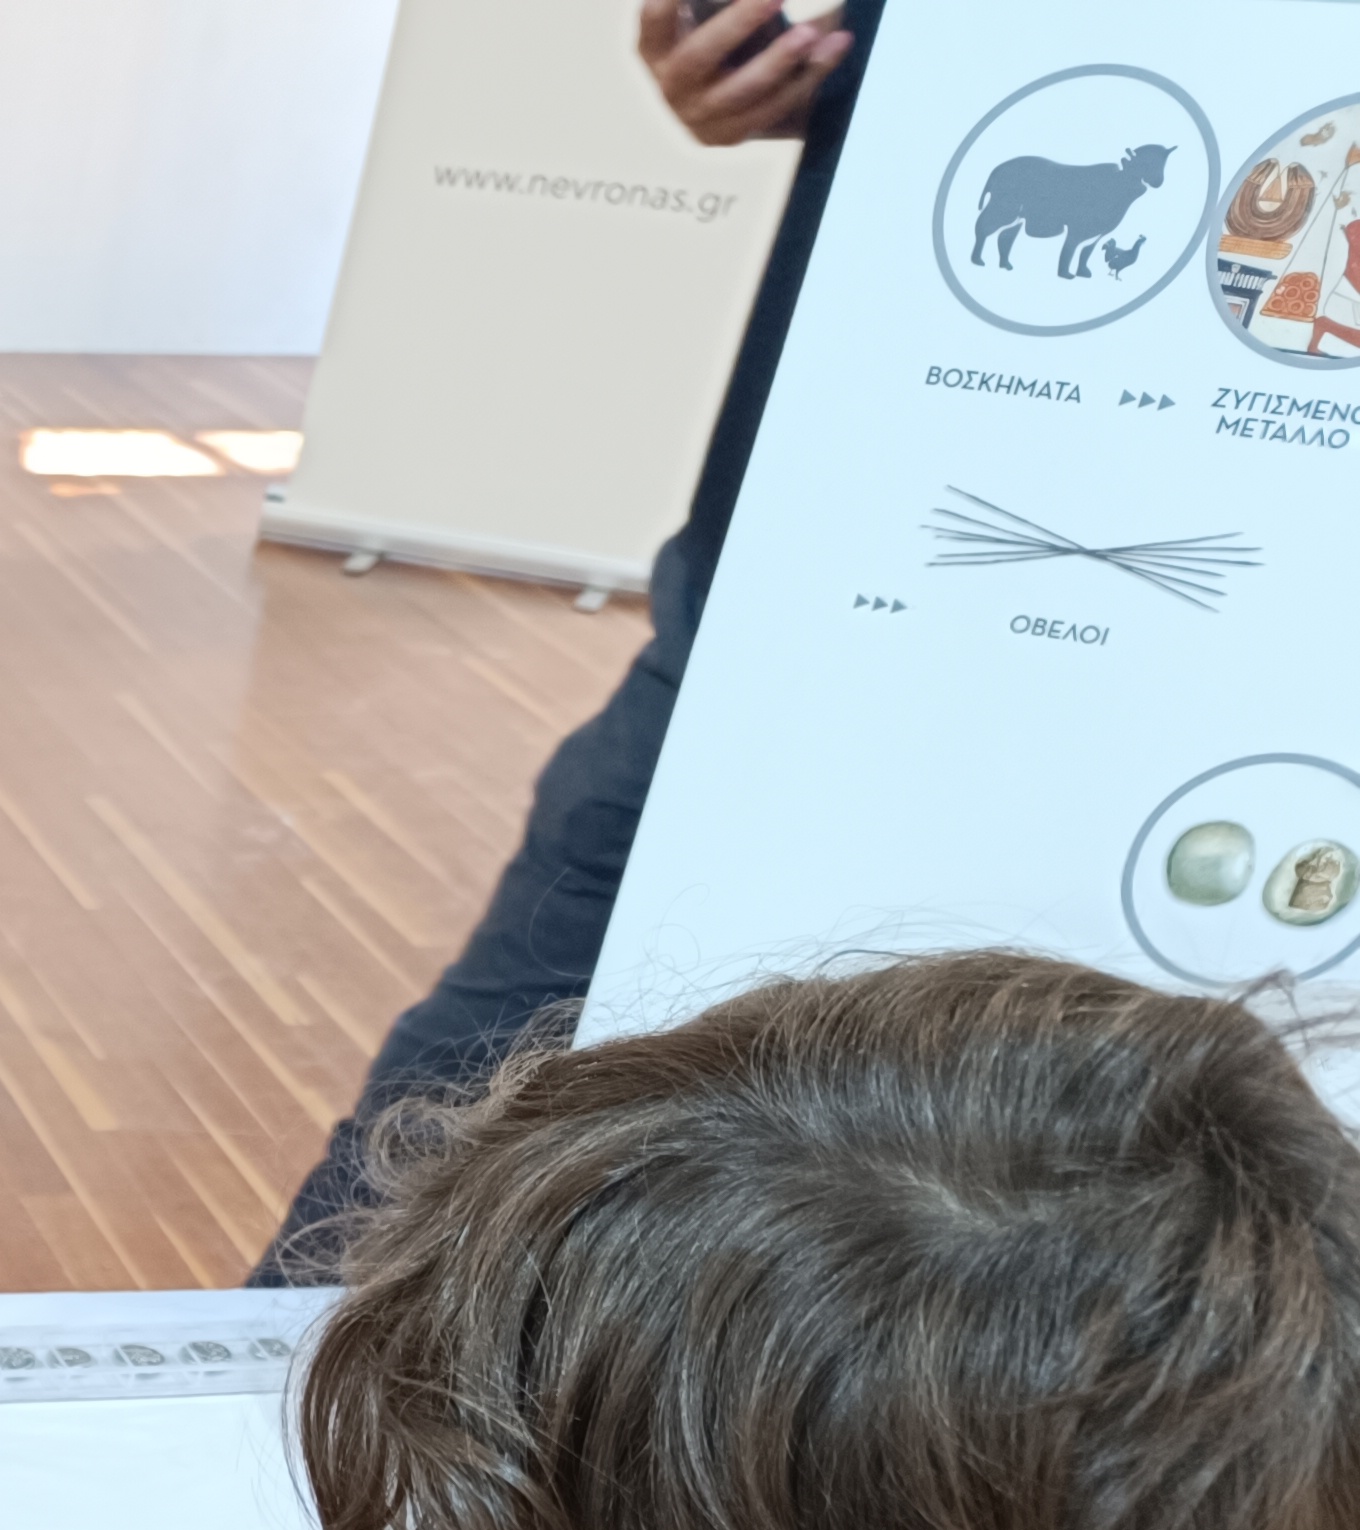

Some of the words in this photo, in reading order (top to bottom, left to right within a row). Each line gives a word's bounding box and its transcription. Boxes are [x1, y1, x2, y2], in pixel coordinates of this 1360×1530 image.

[434, 164, 739, 223] www.nevronas.gr
[925, 365, 1082, 404] ΒΟΣΚΗΜΑΤΑ
[1215, 415, 1351, 449] ΜΕΤΑΛΛΟ
[1009, 614, 1110, 646] ΟΒΕΛΟΙ
